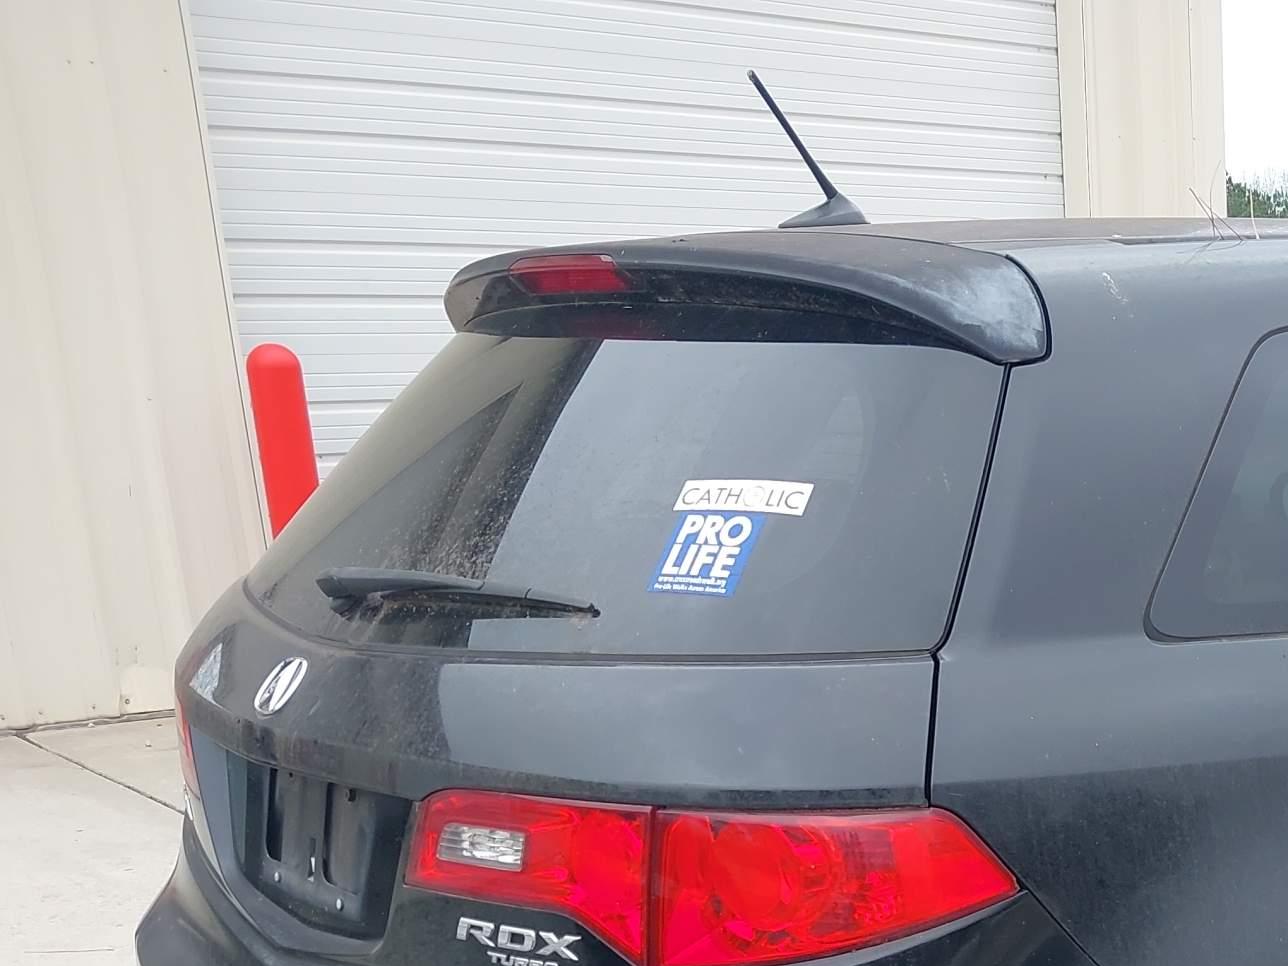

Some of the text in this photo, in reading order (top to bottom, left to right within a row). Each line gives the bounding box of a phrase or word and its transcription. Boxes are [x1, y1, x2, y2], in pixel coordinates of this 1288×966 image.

[682, 486, 805, 509] CATHOLIC
[675, 514, 753, 547] PRO
[661, 543, 741, 578] LIFE
[456, 917, 581, 961] RDX
